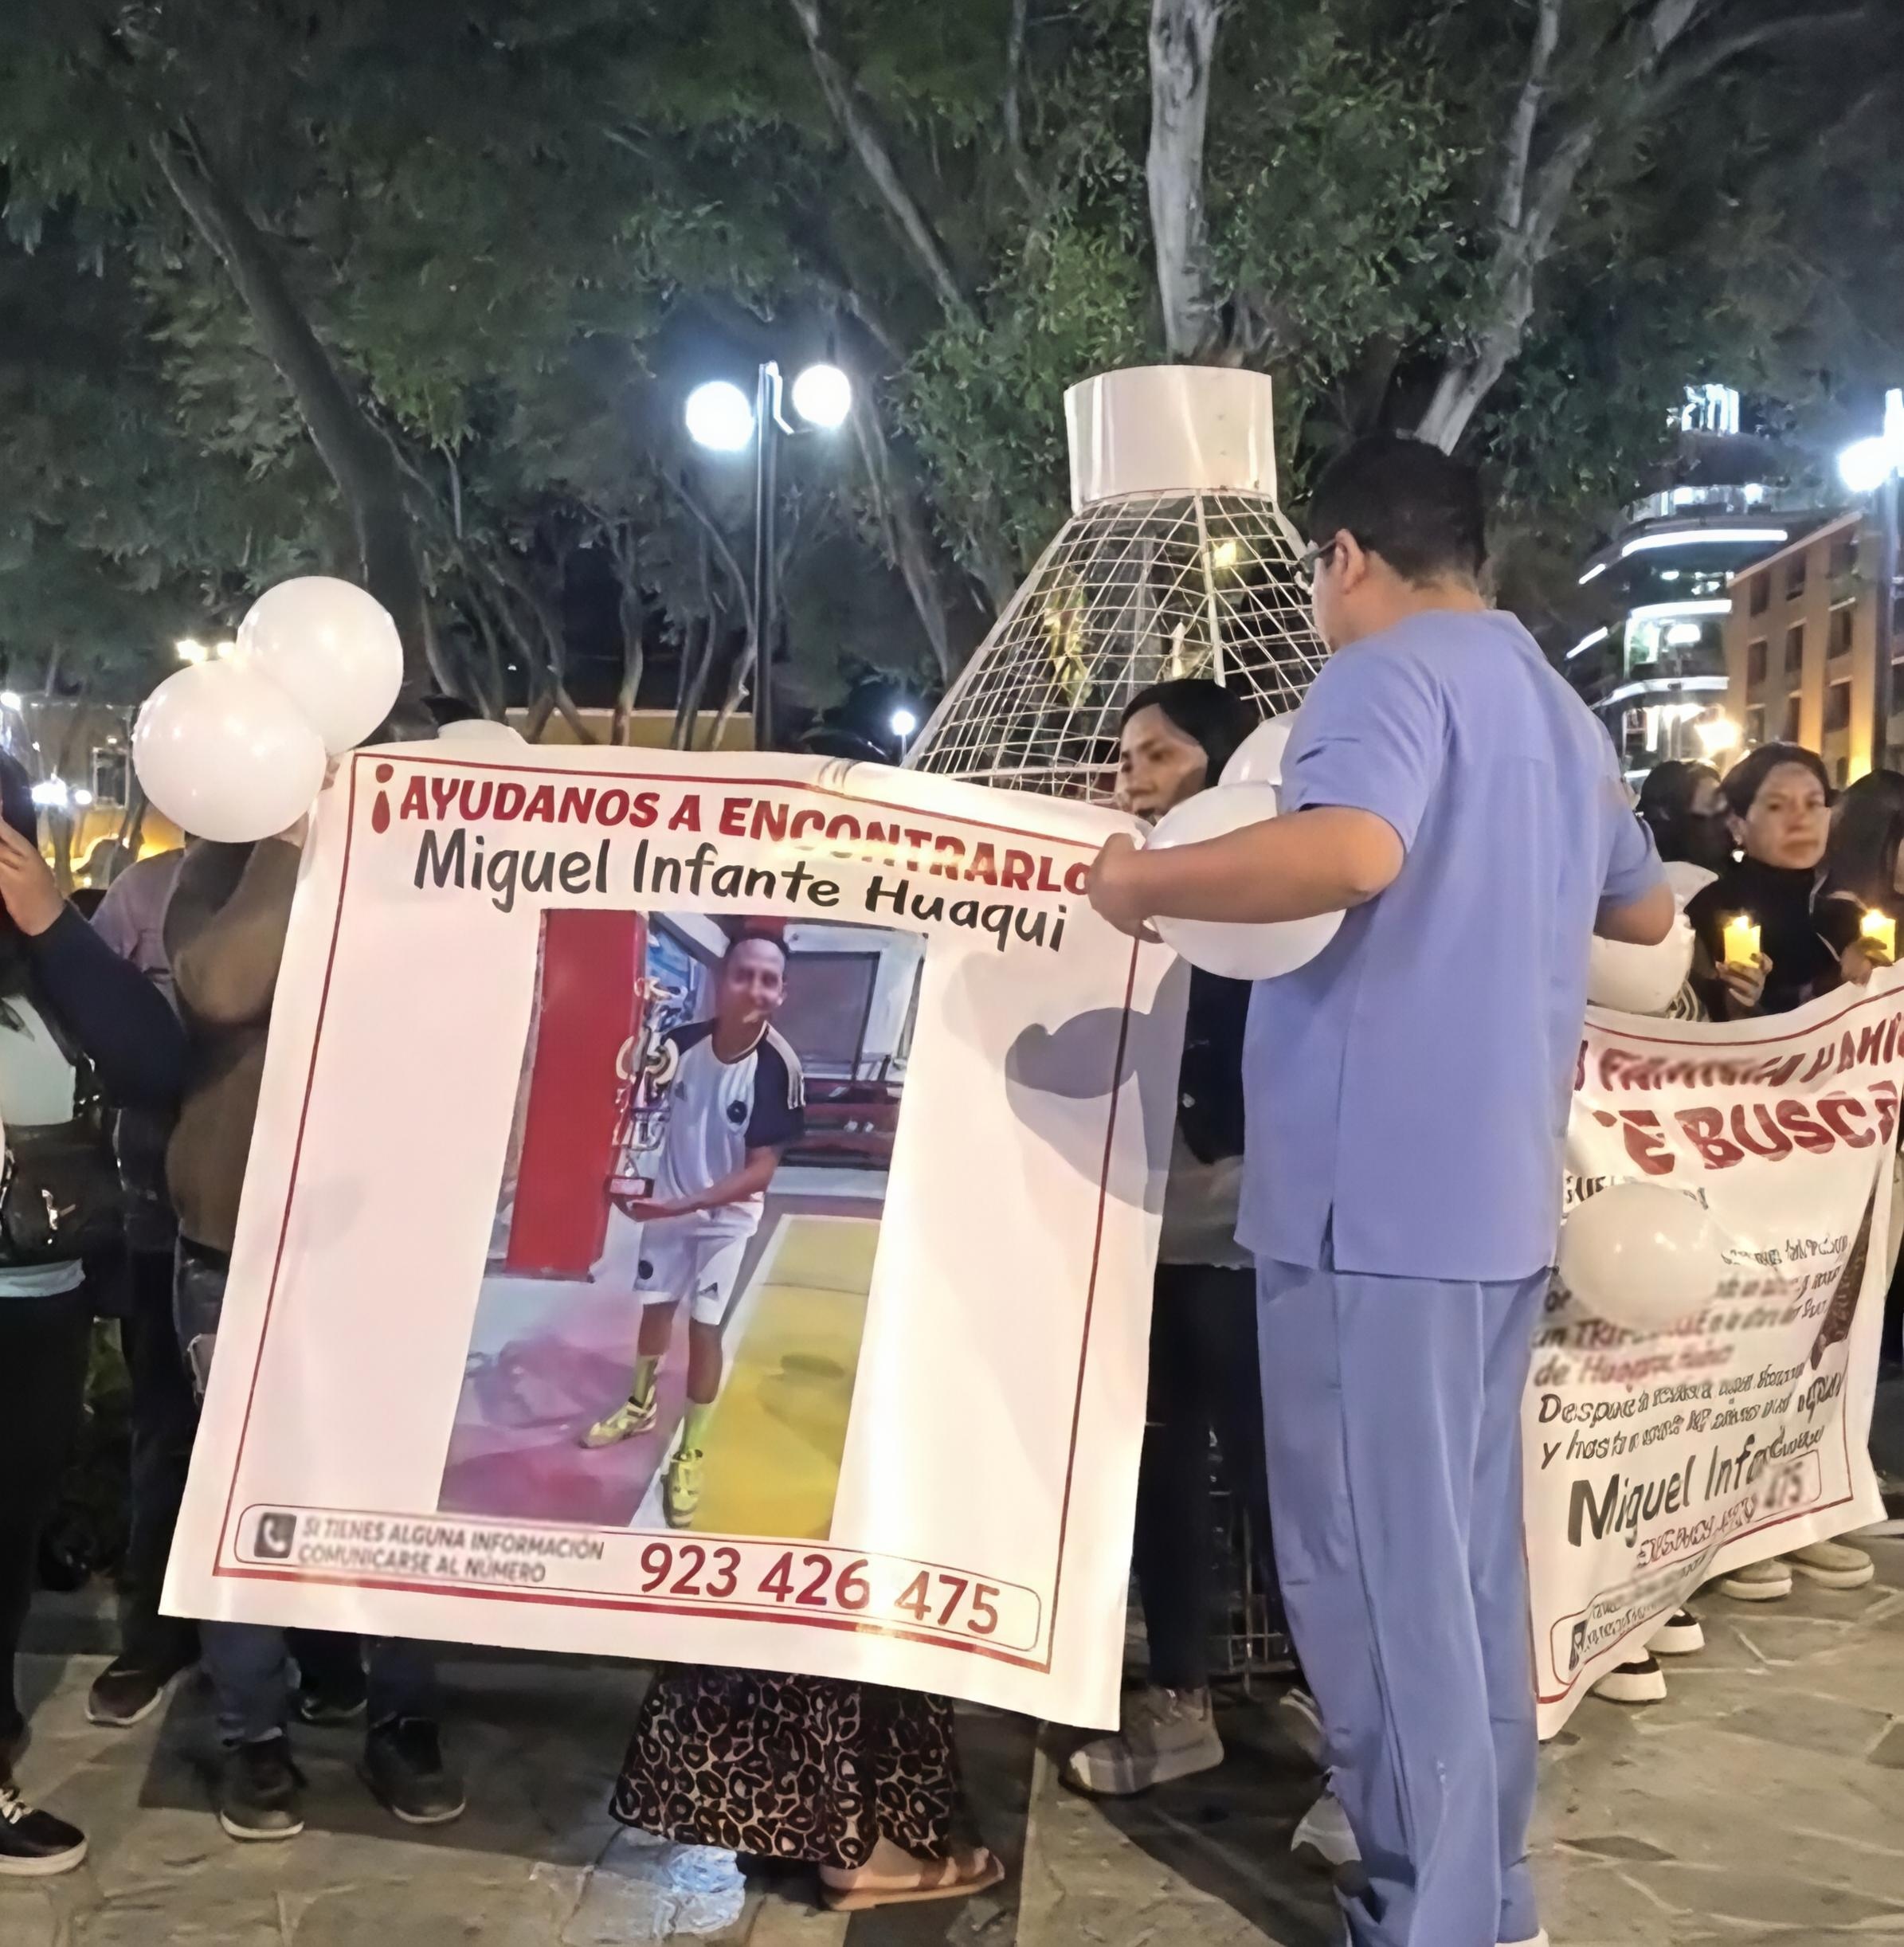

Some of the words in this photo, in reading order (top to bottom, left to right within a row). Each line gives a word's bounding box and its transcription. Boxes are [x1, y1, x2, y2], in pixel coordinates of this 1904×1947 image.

[371, 763, 660, 834] ¡AYUDANOS
[668, 794, 701, 832] A
[413, 828, 611, 914] Miguel
[633, 838, 840, 907] Infante
[865, 876, 1067, 952] Huaqui
[1837, 1012, 1904, 1073] AMI
[1592, 1110, 1675, 1175] E
[1568, 1455, 1696, 1548] Miguel
[297, 1543, 431, 1574] COMUNICARSE
[435, 1551, 460, 1575] AL
[302, 1516, 321, 1539] SI
[324, 1518, 385, 1543] TIENES
[389, 1523, 466, 1549] ALGUNA
[471, 1531, 604, 1560] INFORMACIÓN
[641, 1542, 741, 1597] 923
[758, 1552, 869, 1610] 426
[894, 1570, 1001, 1635] 475
